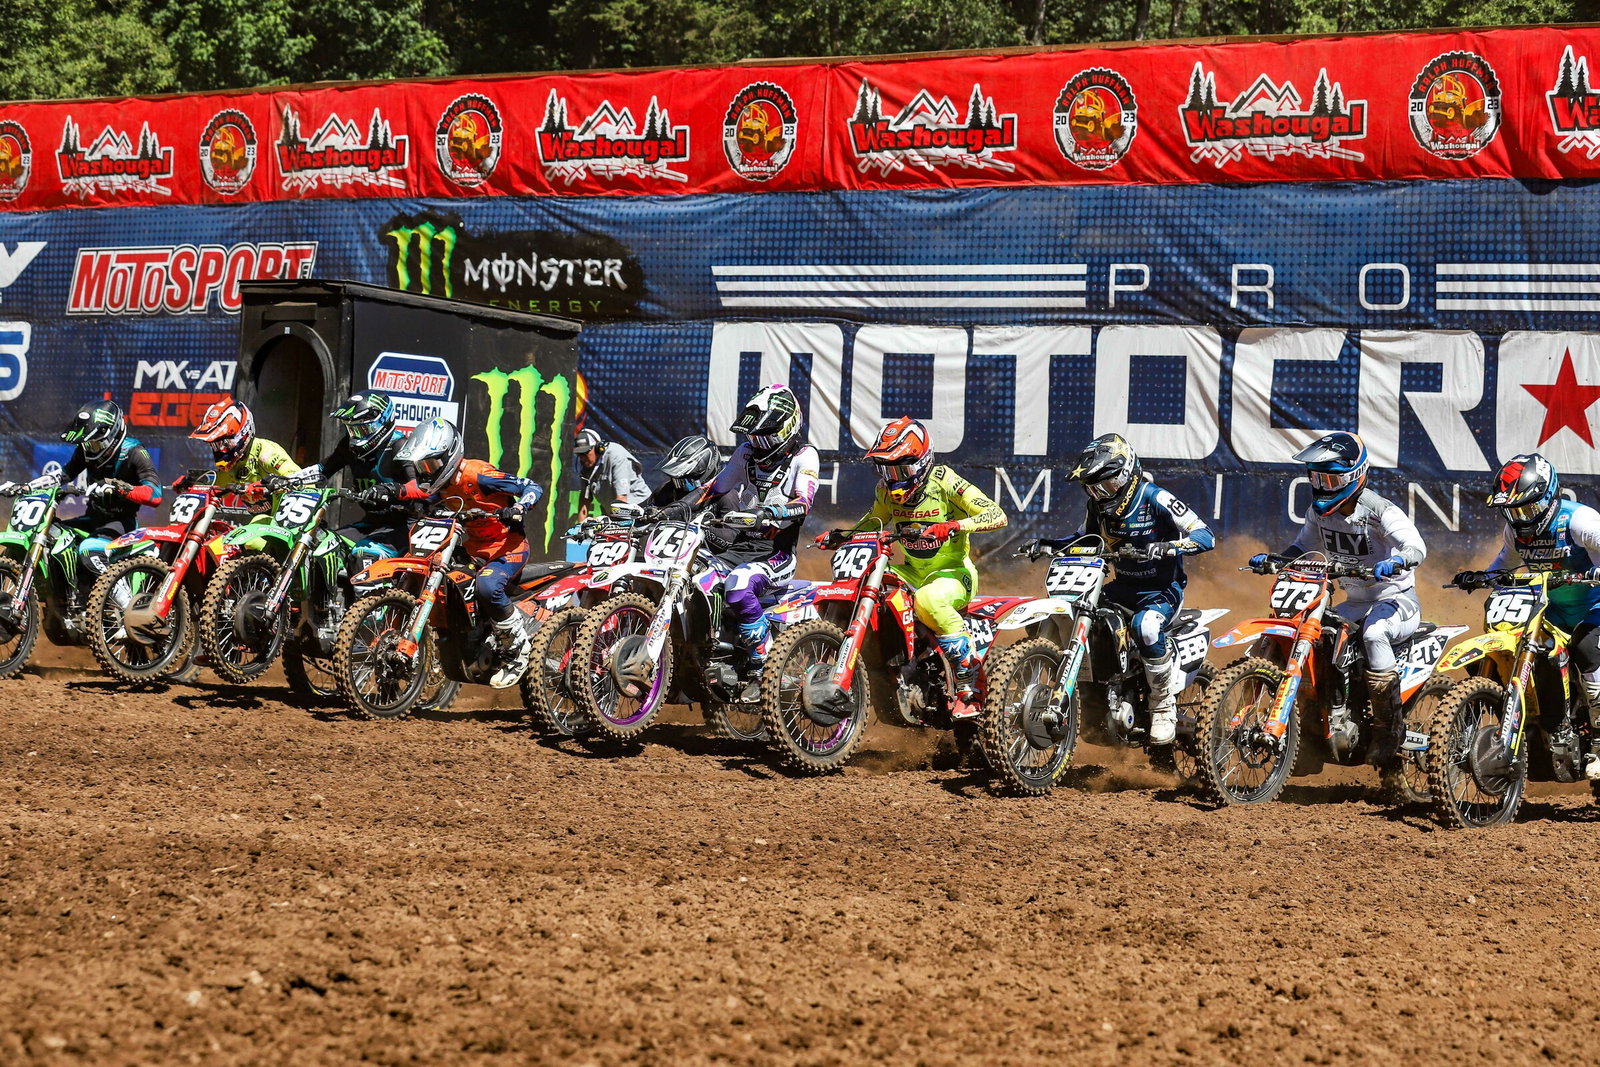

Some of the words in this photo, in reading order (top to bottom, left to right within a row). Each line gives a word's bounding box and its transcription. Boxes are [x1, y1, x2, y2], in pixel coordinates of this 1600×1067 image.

[1124, 112, 1135, 122] 23
[1411, 102, 1423, 112] 20
[1488, 99, 1499, 109] 23
[725, 128, 735, 137] 20
[785, 126, 795, 135] 23
[1056, 115, 1067, 125] 20
[1182, 105, 1364, 142] Washougal
[539, 130, 687, 164] Washougal
[851, 119, 1013, 152] Washougal
[58, 149, 173, 180] Washougal
[277, 138, 405, 172] Washougal
[463, 251, 628, 293] MONSTER
[488, 300, 601, 313] ENERGY
[133, 360, 189, 389] MX
[195, 361, 238, 389] AT
[1115, 474, 1139, 516] ROCKSTAR
[10, 500, 47, 526] 30
[169, 497, 200, 524] 33
[275, 496, 318, 524] 35
[892, 508, 940, 519] GASGAS
[410, 525, 449, 551] 42
[649, 526, 699, 557] 43
[901, 537, 920, 550] Red
[921, 536, 941, 550] Bull
[1322, 530, 1366, 556] FLY
[588, 541, 629, 567] 159
[833, 547, 872, 579] 243
[1047, 565, 1101, 592] 339
[1270, 581, 1320, 610] 273
[1486, 593, 1534, 624] 85
[648, 609, 666, 647] DUNLOP
[839, 643, 851, 669] DUNLOP
[1177, 634, 1208, 666] 339
